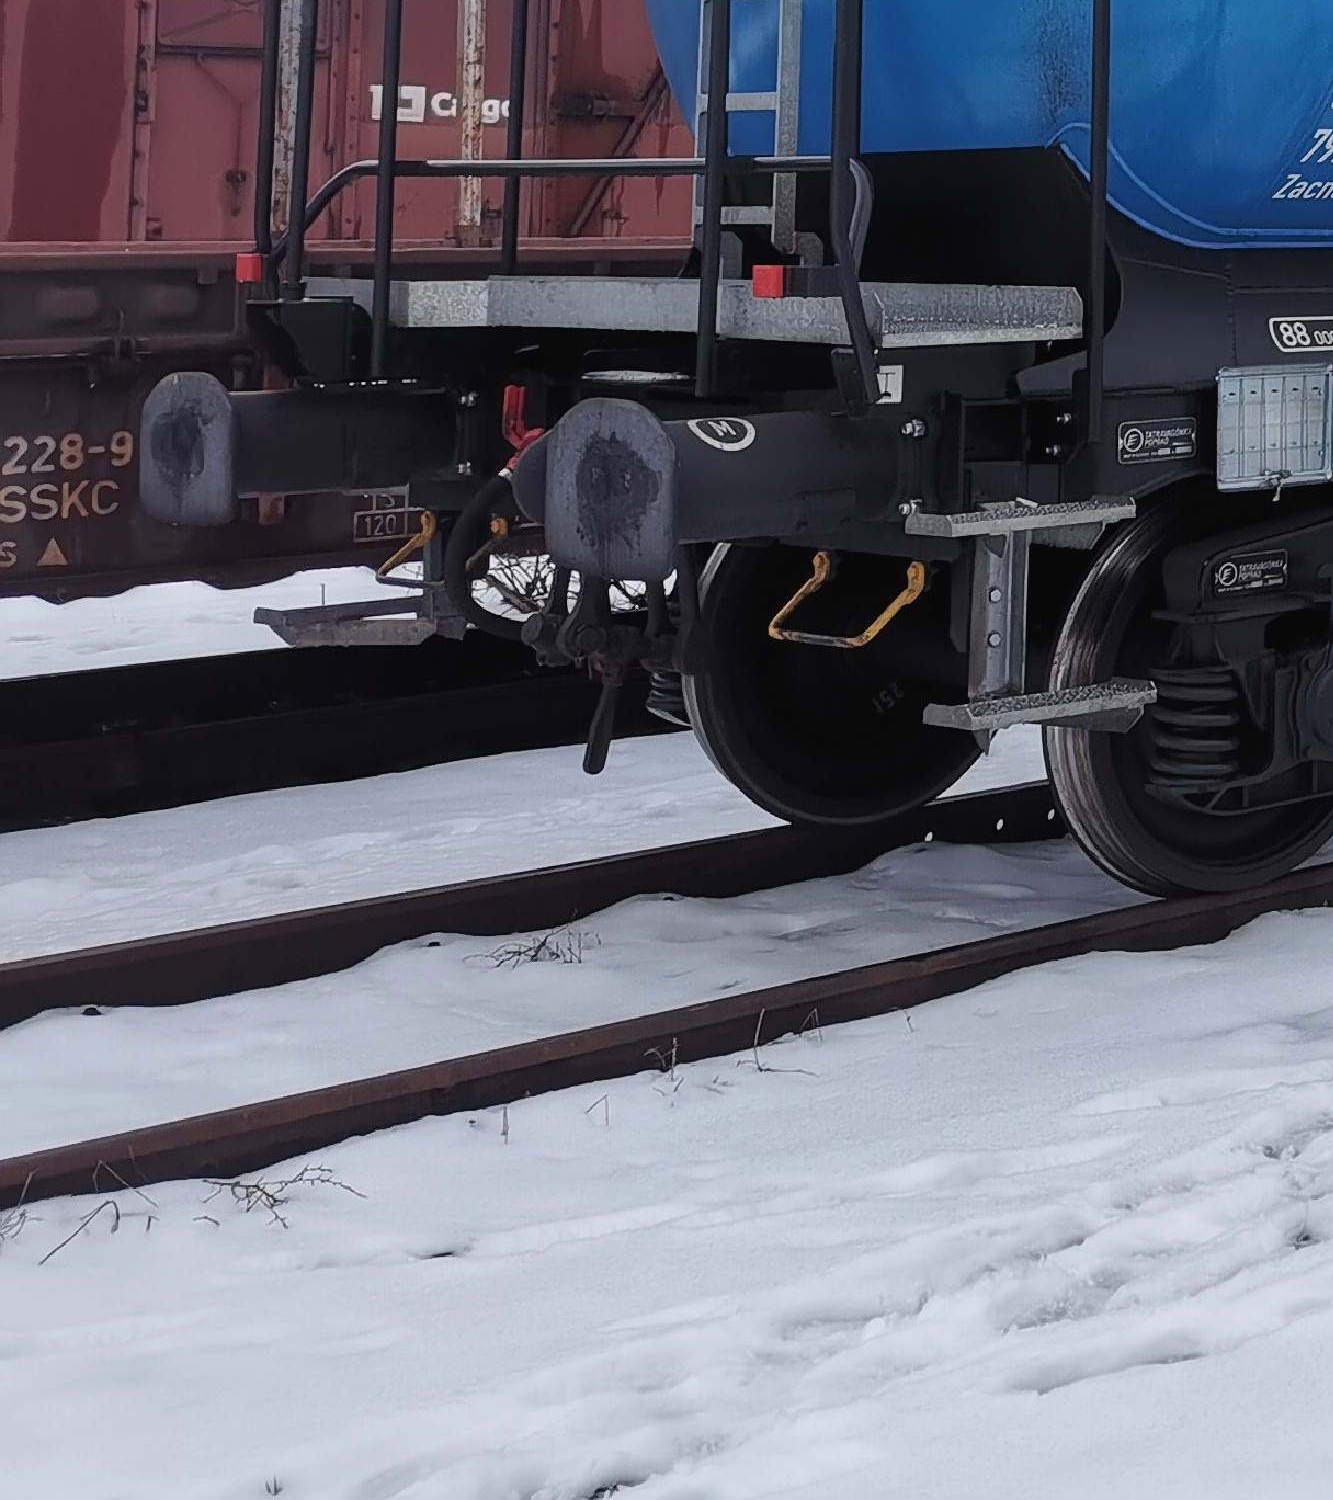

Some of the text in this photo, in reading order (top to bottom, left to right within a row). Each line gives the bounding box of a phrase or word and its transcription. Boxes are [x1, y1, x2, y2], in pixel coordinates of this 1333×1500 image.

[1280, 322, 1311, 346] 88
[1, 430, 134, 475] 228-9
[365, 514, 397, 536] 120
